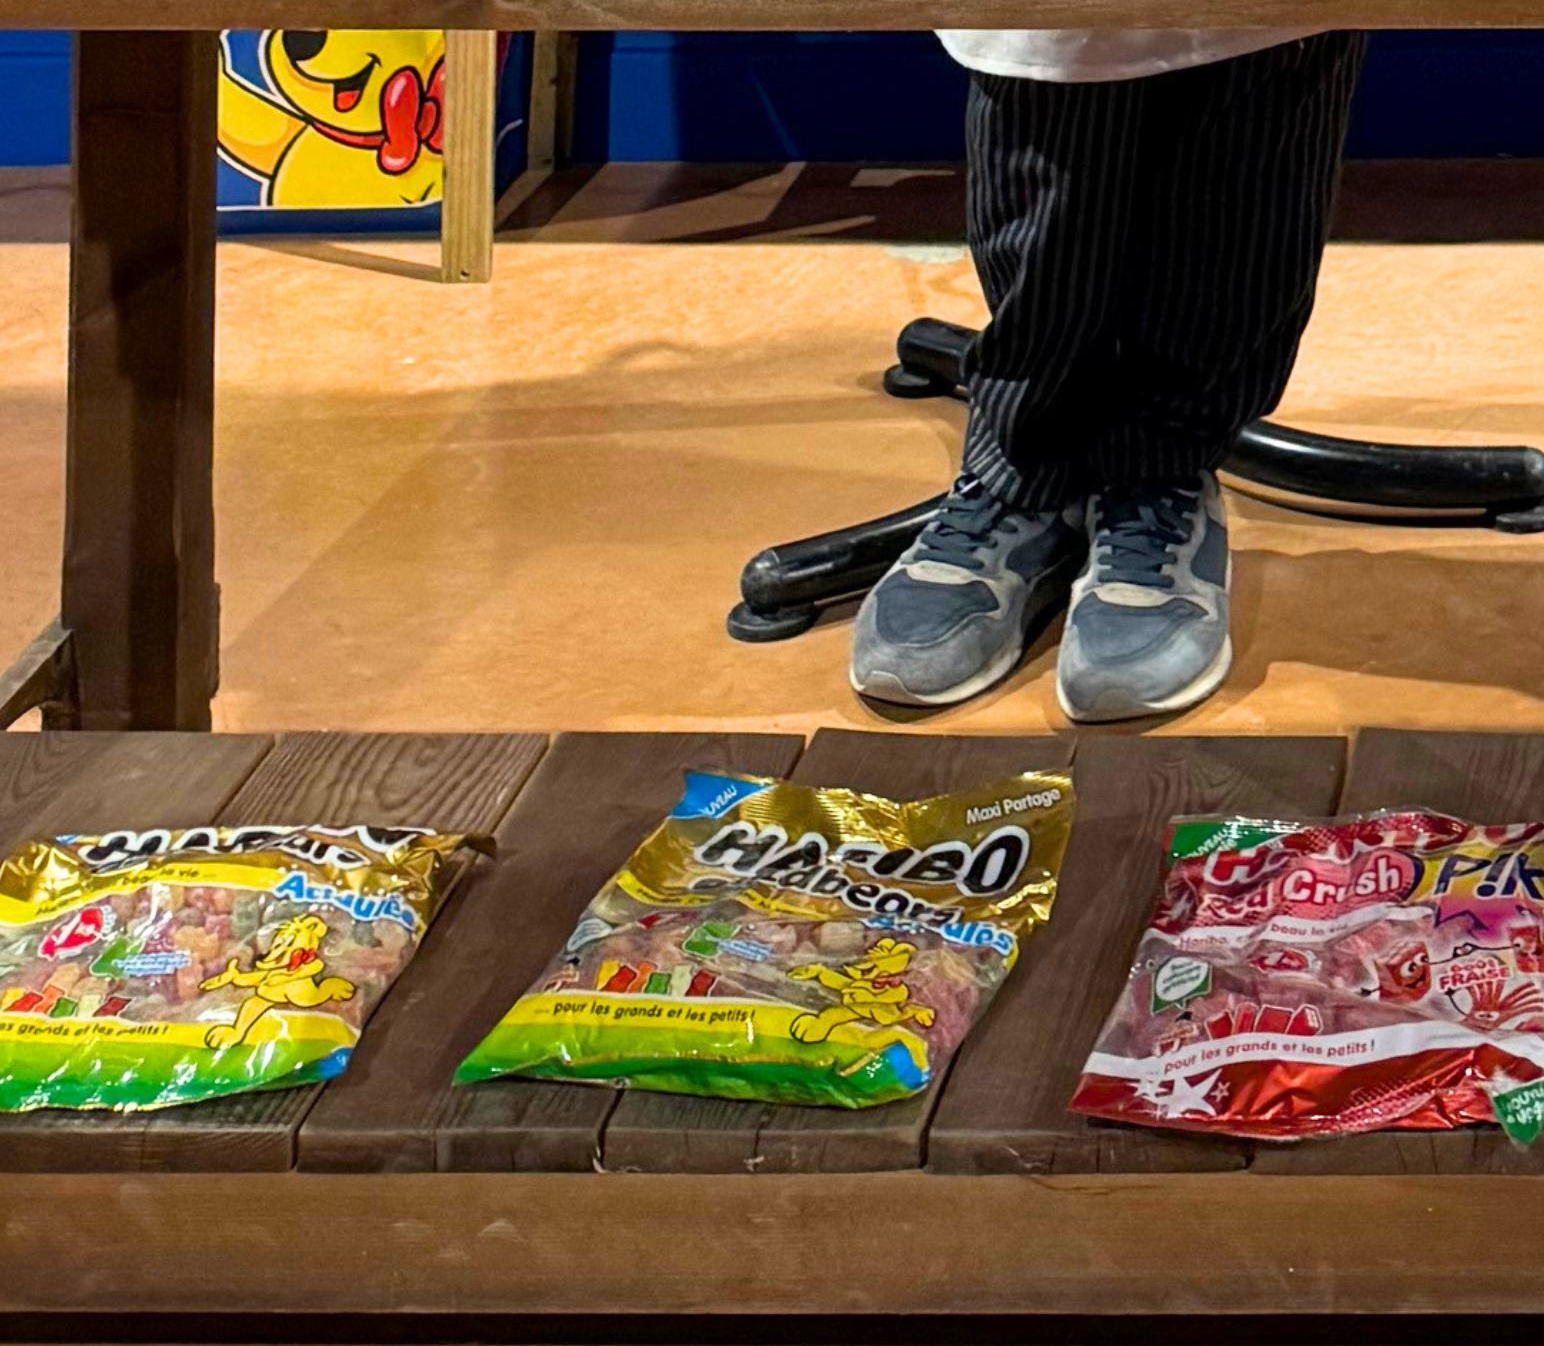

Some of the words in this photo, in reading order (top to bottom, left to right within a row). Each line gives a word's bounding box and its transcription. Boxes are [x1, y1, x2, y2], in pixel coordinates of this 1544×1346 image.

[966, 800, 1002, 825] Maxi
[1002, 788, 1061, 815] Partage
[553, 1001, 587, 1015] pour
[590, 1000, 610, 1015] les
[614, 1003, 662, 1020] grands
[667, 1007, 683, 1019] et
[685, 1007, 706, 1022] les
[17, 1022, 71, 1036] grands
[1164, 1057, 1197, 1075] pour
[1201, 1047, 1221, 1061] les
[1226, 1041, 1278, 1058] grands
[1282, 1042, 1297, 1052] et
[1302, 1043, 1322, 1055] les
